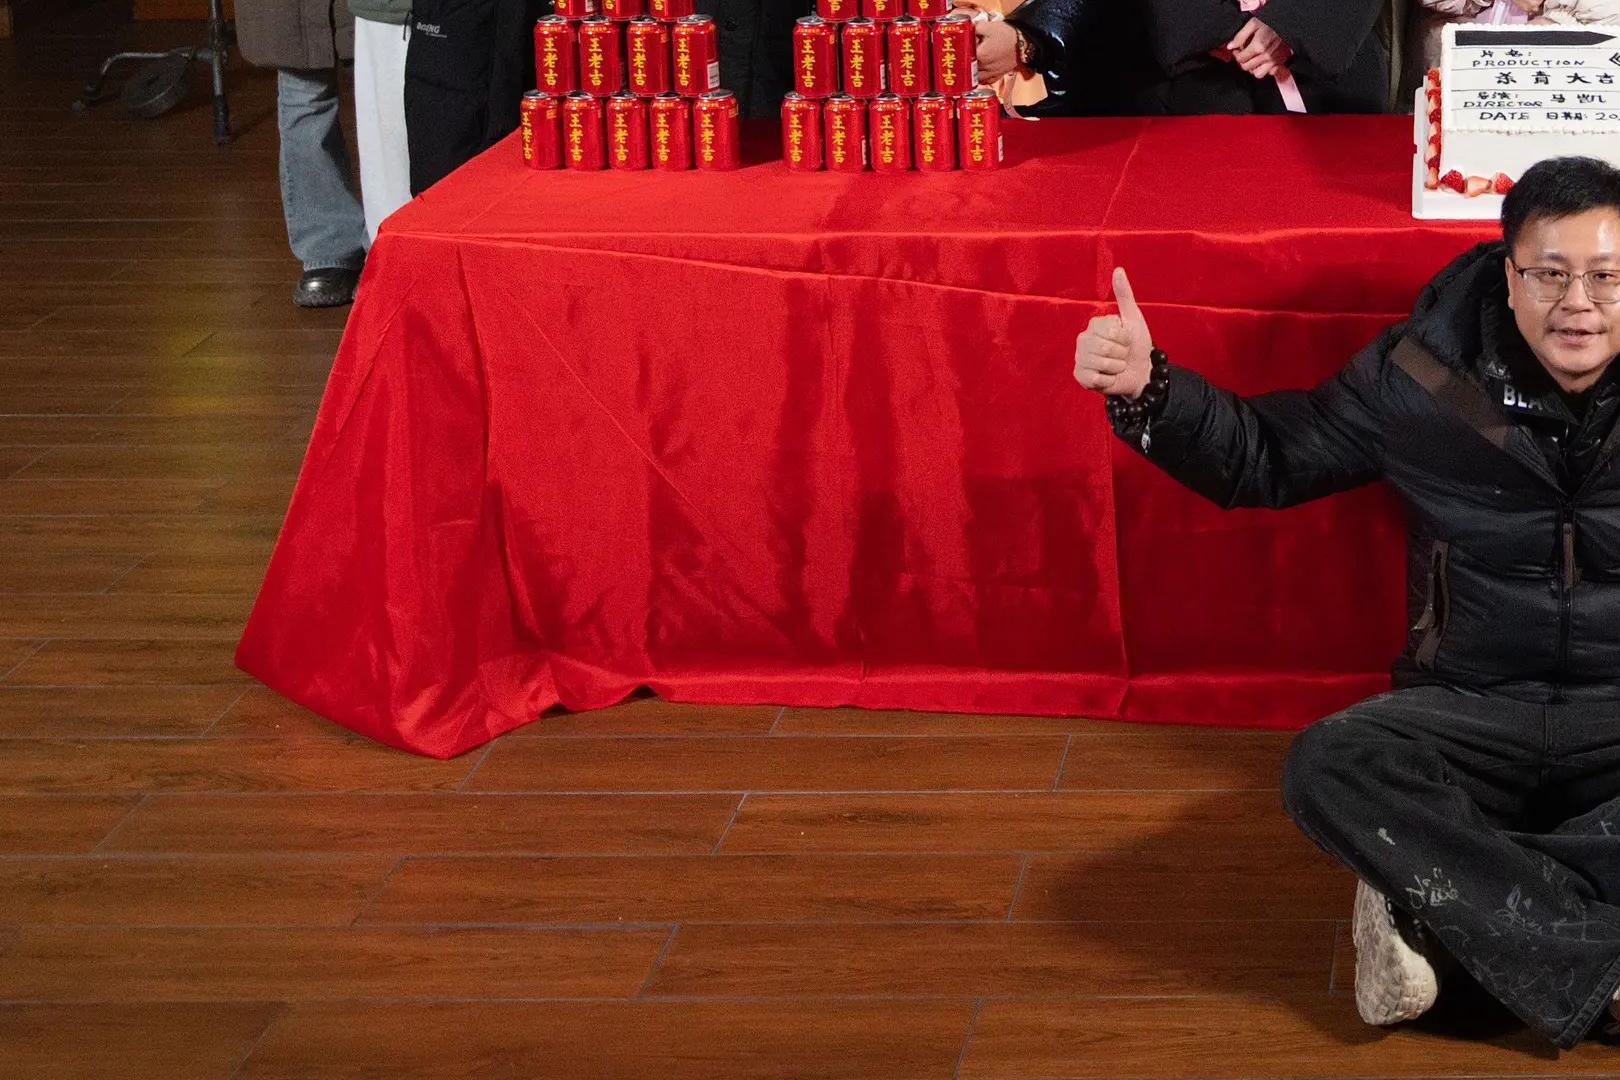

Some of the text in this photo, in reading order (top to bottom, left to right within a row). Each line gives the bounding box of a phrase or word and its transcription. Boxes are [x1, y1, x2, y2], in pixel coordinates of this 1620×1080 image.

[543, 36, 558, 86] 王老吉
[588, 36, 604, 86] 王老吉
[633, 36, 647, 86] 王老吉
[678, 37, 690, 87] 王老吉
[802, 37, 816, 87] 王老吉
[850, 37, 864, 87] 王老吉
[900, 36, 915, 86] 王老吉
[942, 36, 956, 86] 王老吉
[1472, 59, 1585, 68] PRODUCTION
[1495, 70, 1616, 86] 杀青大吉
[1463, 101, 1544, 109] DIRECTOR
[1479, 111, 1531, 121] DATE
[522, 110, 533, 160] 王老吉
[569, 111, 583, 161] 王老吉
[615, 111, 628, 161] 王老吉
[657, 111, 670, 161] 王老吉
[701, 111, 714, 161] 王老吉
[789, 112, 803, 162] 王老吉
[832, 113, 846, 163] 王老吉
[880, 113, 894, 163] 王老吉
[922, 112, 935, 162] 王老吉
[970, 111, 985, 161] 王老吉
